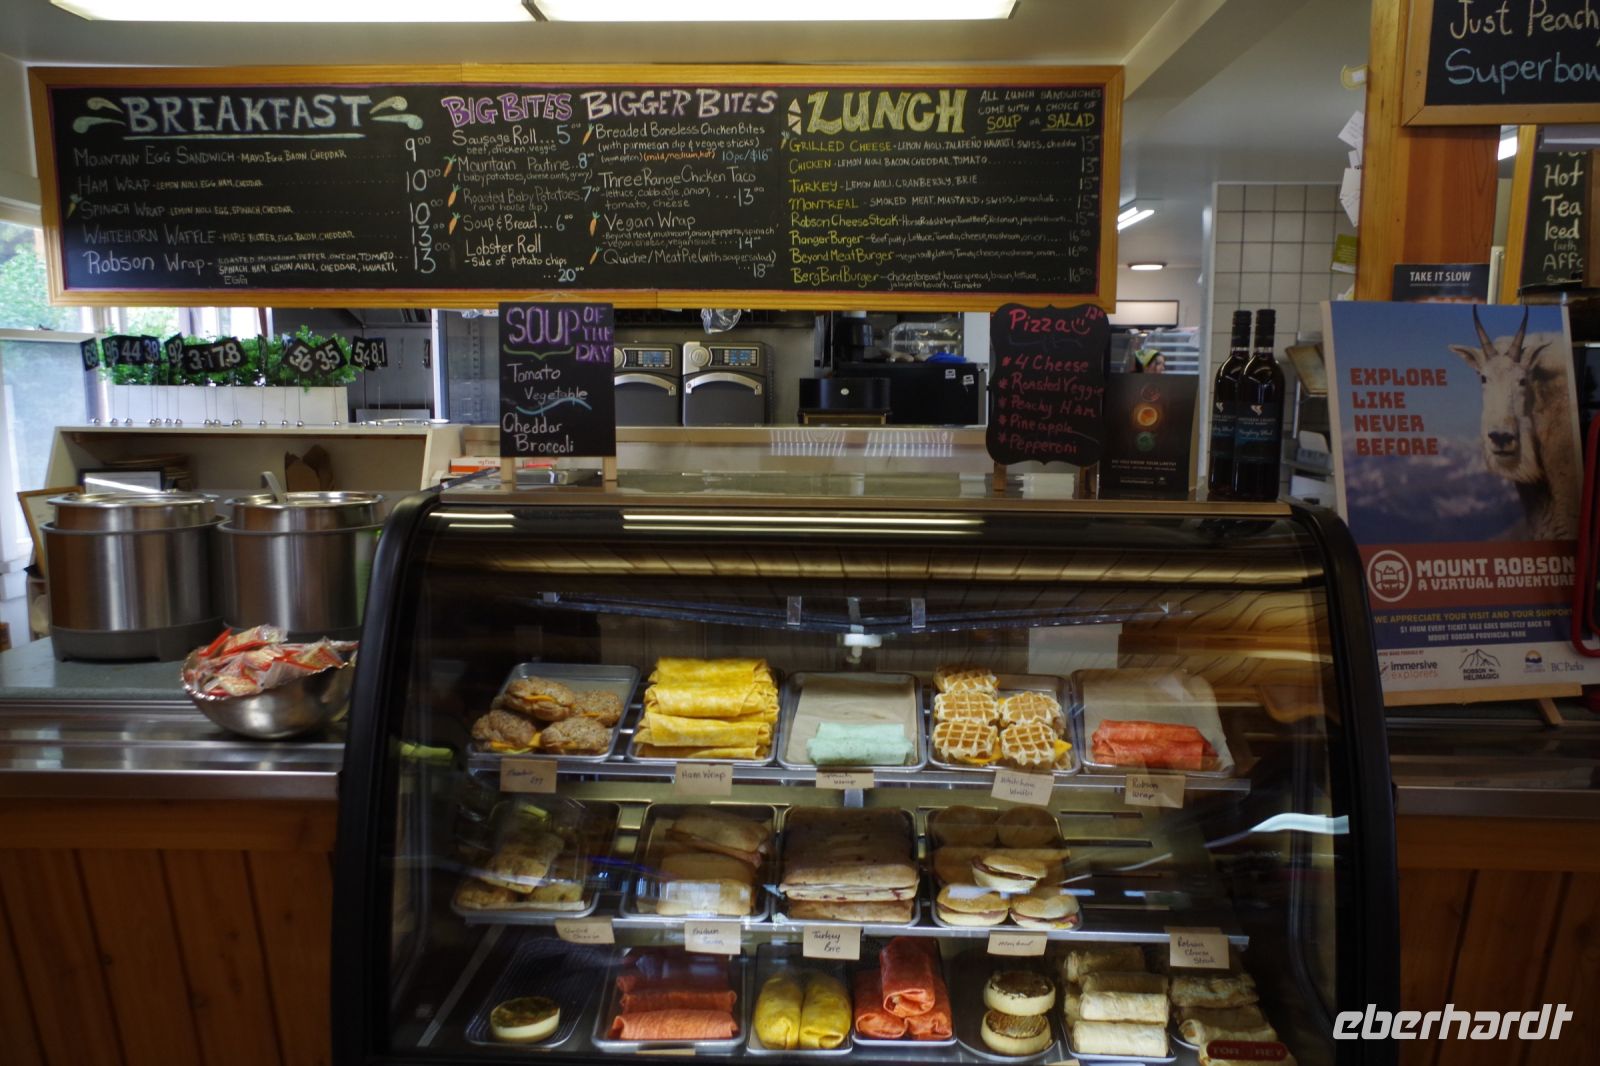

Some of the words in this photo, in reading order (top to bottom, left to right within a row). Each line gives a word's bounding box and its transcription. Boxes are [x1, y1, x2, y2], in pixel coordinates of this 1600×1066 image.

[1450, 0, 1513, 39] Just
[1527, 0, 1600, 48] Peach
[580, 89, 692, 120] BIGGER
[696, 88, 779, 118] BITES
[979, 89, 999, 103] ALL
[1005, 90, 1035, 102] LUNCH
[121, 94, 373, 132] BREAKFAST
[441, 96, 498, 128] BIG
[497, 92, 573, 122] BITES
[807, 88, 969, 135] LUNCH
[978, 105, 1004, 116] COME
[1007, 103, 1029, 113] WITH
[1035, 104, 1042, 113] A
[1046, 101, 1079, 111] CHOICE
[595, 120, 648, 141] Breaded
[650, 120, 700, 139] Boneless
[701, 121, 738, 138] Chicken
[739, 121, 766, 137] Bites
[986, 114, 1022, 131] SOUP
[1046, 112, 1096, 130] SALAD
[452, 129, 510, 148] Sausage
[513, 124, 537, 145] Roll
[788, 138, 845, 153] GRILLED
[849, 139, 893, 152] CHEESE
[177, 145, 235, 164] SANDWICH
[624, 141, 670, 157] parmesan
[671, 138, 688, 152] dip
[696, 139, 726, 152] veggie
[457, 156, 517, 173] Mountain
[788, 158, 832, 175] CHICKEN
[952, 156, 988, 168] TOMATO
[1544, 159, 1584, 189] Hot
[79, 175, 109, 193] HAM
[115, 176, 151, 192] WRAP
[598, 170, 645, 190] Three
[680, 162, 725, 184] Chicken
[726, 163, 758, 183] Taco
[787, 178, 840, 194] TURKEY
[845, 179, 871, 192] LEMON
[954, 174, 978, 186] BRIE
[463, 187, 505, 205] Roasted
[507, 187, 535, 204] Baby
[653, 199, 691, 208] cheese
[788, 197, 859, 211] MONTREAL
[868, 196, 907, 208] SMOKED
[1541, 193, 1582, 218] Tea
[81, 200, 130, 220] SPINACH
[134, 202, 165, 218] WRAP
[789, 210, 830, 228] Robson
[831, 213, 869, 227] Cheese
[868, 212, 899, 228] Steak
[462, 213, 497, 232] Soup
[504, 210, 539, 232] Bread
[603, 212, 654, 231] Vegan
[656, 210, 696, 230] Wrap
[1544, 217, 1580, 241] Iced
[83, 222, 159, 245] WHITEHORN
[164, 223, 217, 246] WAFFLE
[788, 230, 830, 246] Ranger
[827, 230, 865, 248] Burger
[465, 233, 515, 257] Lobster
[517, 232, 542, 255] Roll
[82, 249, 156, 275] Robson
[495, 255, 507, 266] of
[512, 254, 544, 269] potato
[788, 247, 829, 265] Beyond
[829, 248, 856, 262] Meat
[855, 247, 895, 266] Burger
[789, 266, 821, 287] Berg
[841, 265, 880, 288] Burger
[1409, 271, 1432, 282] TAKE
[1434, 271, 1444, 282] IT
[1445, 271, 1472, 282] SLOW
[583, 306, 606, 323] OF
[1008, 308, 1071, 333] Pizza
[506, 305, 580, 346] SOUP
[121, 341, 142, 362] 44
[211, 342, 241, 368] 78
[289, 345, 313, 373] 56
[315, 343, 340, 371] 35
[575, 344, 611, 363] DAY
[507, 363, 561, 383] Tomato
[1032, 353, 1089, 373] Cheese
[1350, 367, 1447, 386] EXPLORE
[524, 385, 589, 406] Vegetable
[1352, 391, 1405, 409] LIKE
[502, 412, 563, 434] Cheddar
[1354, 414, 1424, 432] NEVER
[514, 434, 574, 453] Broccoli
[1356, 437, 1439, 456] BEFORE
[1416, 558, 1488, 578] MOUNT
[1493, 555, 1575, 577] ROBSON
[1418, 579, 1428, 591] A
[1431, 576, 1494, 590] VIRTUAL
[1497, 573, 1576, 588] ADVENTURE
[1375, 615, 1388, 624] WE
[1390, 613, 1443, 623] APPRECIATE
[1444, 612, 1467, 622] YOUR
[1468, 611, 1489, 621] VISIT
[1490, 611, 1510, 621] AND
[1511, 609, 1534, 620] YOUR
[1428, 632, 1449, 642] MOUNT
[1475, 630, 1510, 640] PROVINCIAL
[1511, 629, 1527, 639] PARK
[1391, 660, 1438, 671] immersive
[1392, 670, 1439, 680] explorers
